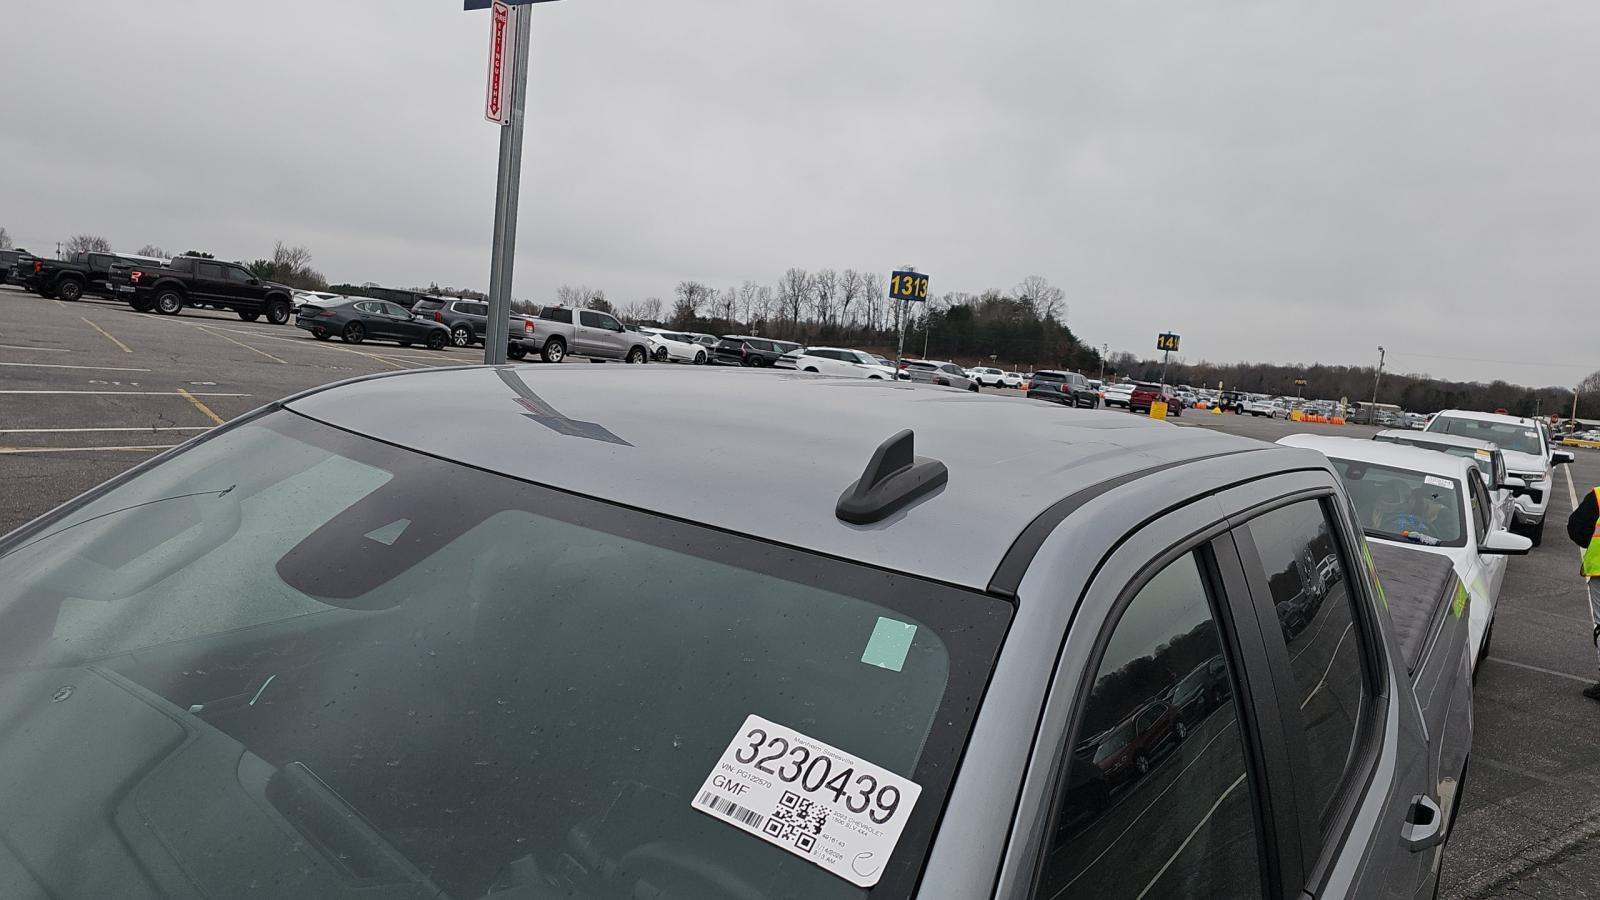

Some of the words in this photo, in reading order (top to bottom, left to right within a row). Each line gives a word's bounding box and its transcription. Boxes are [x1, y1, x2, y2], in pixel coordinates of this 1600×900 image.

[1159, 336, 1173, 348] 14
[712, 774, 750, 797] GMF
[735, 728, 901, 824] 3230439
[735, 769, 772, 789] PG122570
